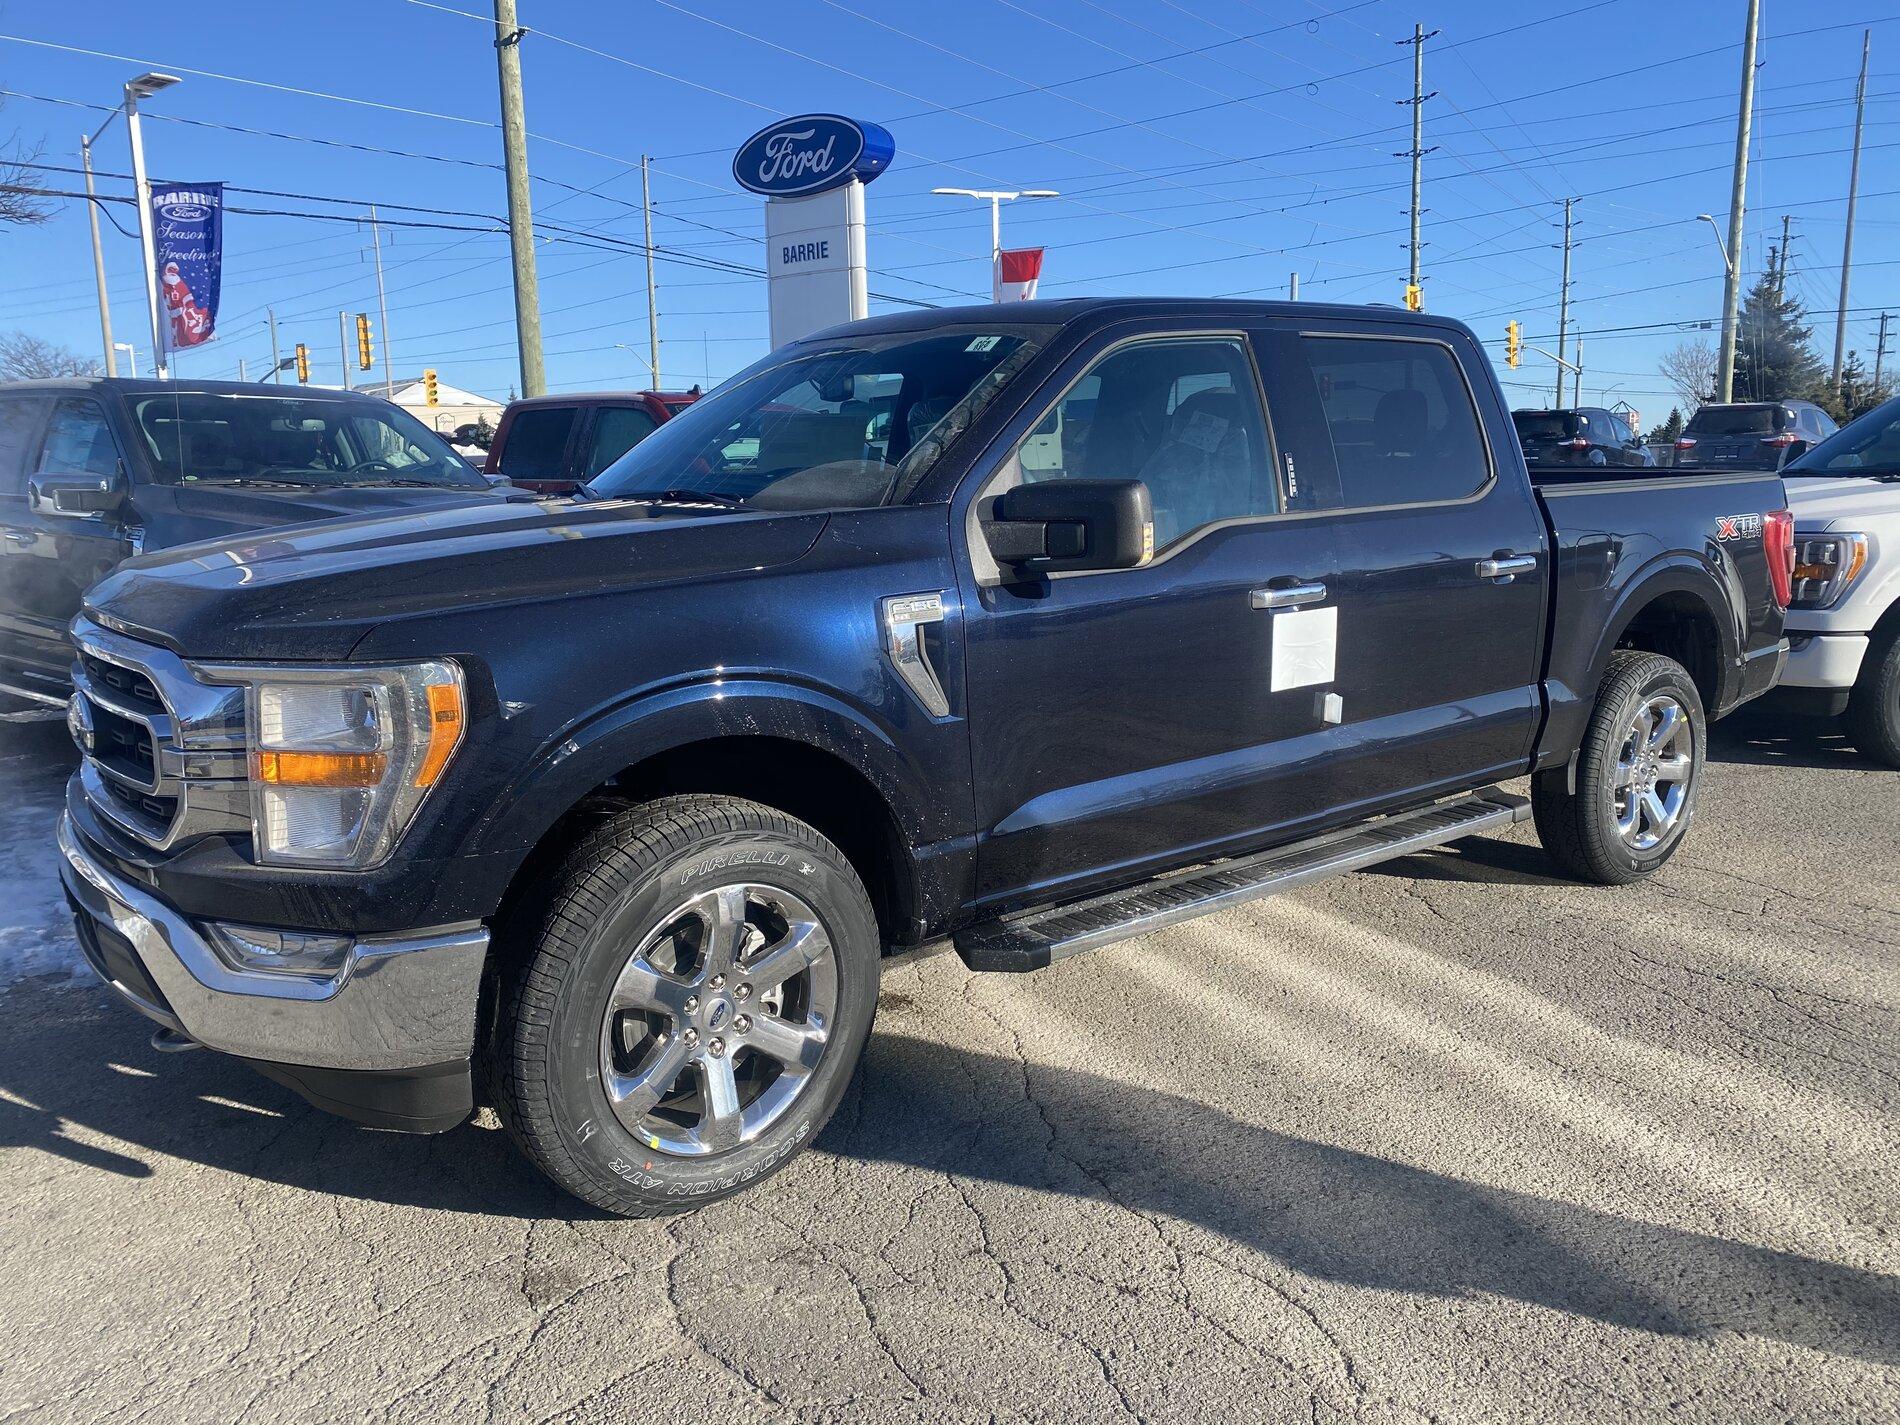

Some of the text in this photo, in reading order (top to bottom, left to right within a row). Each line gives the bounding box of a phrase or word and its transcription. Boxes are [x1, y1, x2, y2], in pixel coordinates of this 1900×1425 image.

[758, 128, 836, 183] Ford
[153, 191, 219, 209] BARRIE
[172, 206, 202, 218] Ford
[783, 240, 829, 264] BARRIE
[1715, 513, 1761, 542] XTR
[680, 850, 791, 885] PIRELLI
[608, 1120, 810, 1196] SCORPION ATR
